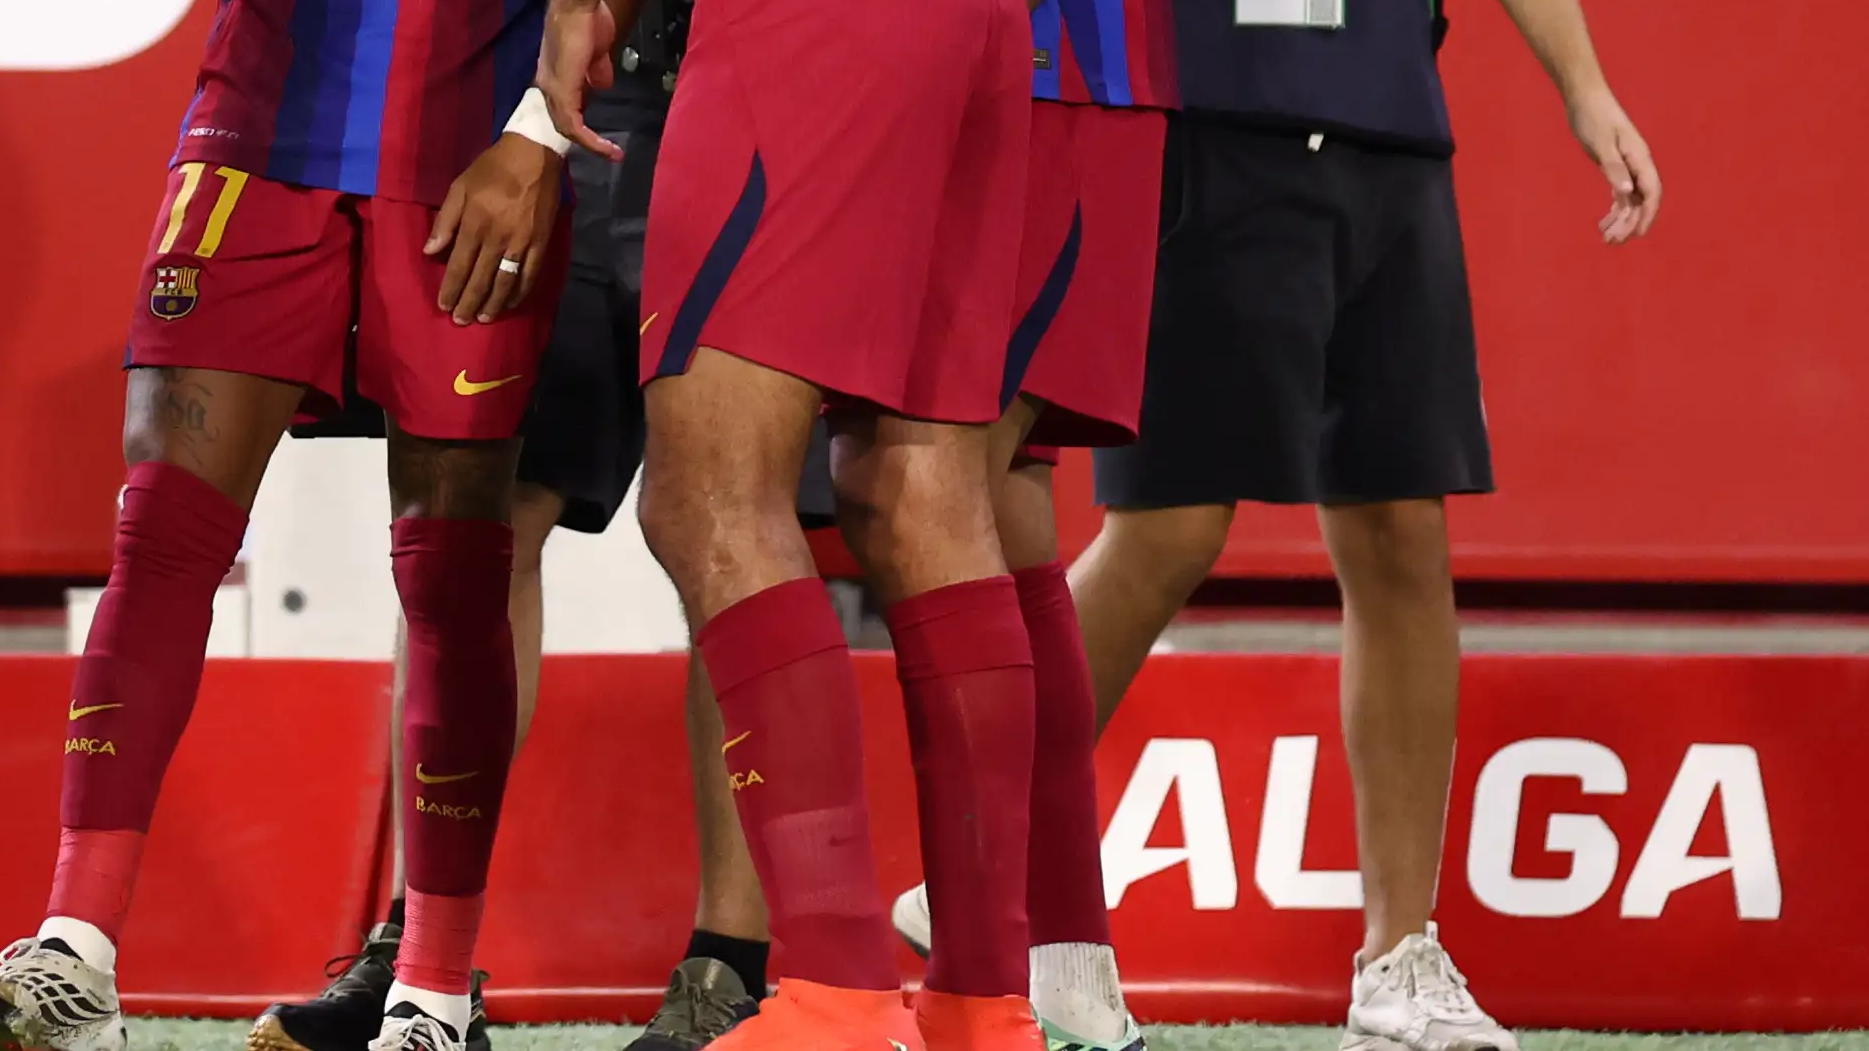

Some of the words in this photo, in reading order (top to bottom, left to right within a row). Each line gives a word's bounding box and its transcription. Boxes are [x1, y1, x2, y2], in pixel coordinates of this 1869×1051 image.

[159, 161, 249, 258] 11
[416, 796, 482, 821] BARÇA
[1100, 734, 1782, 920] ALGA
